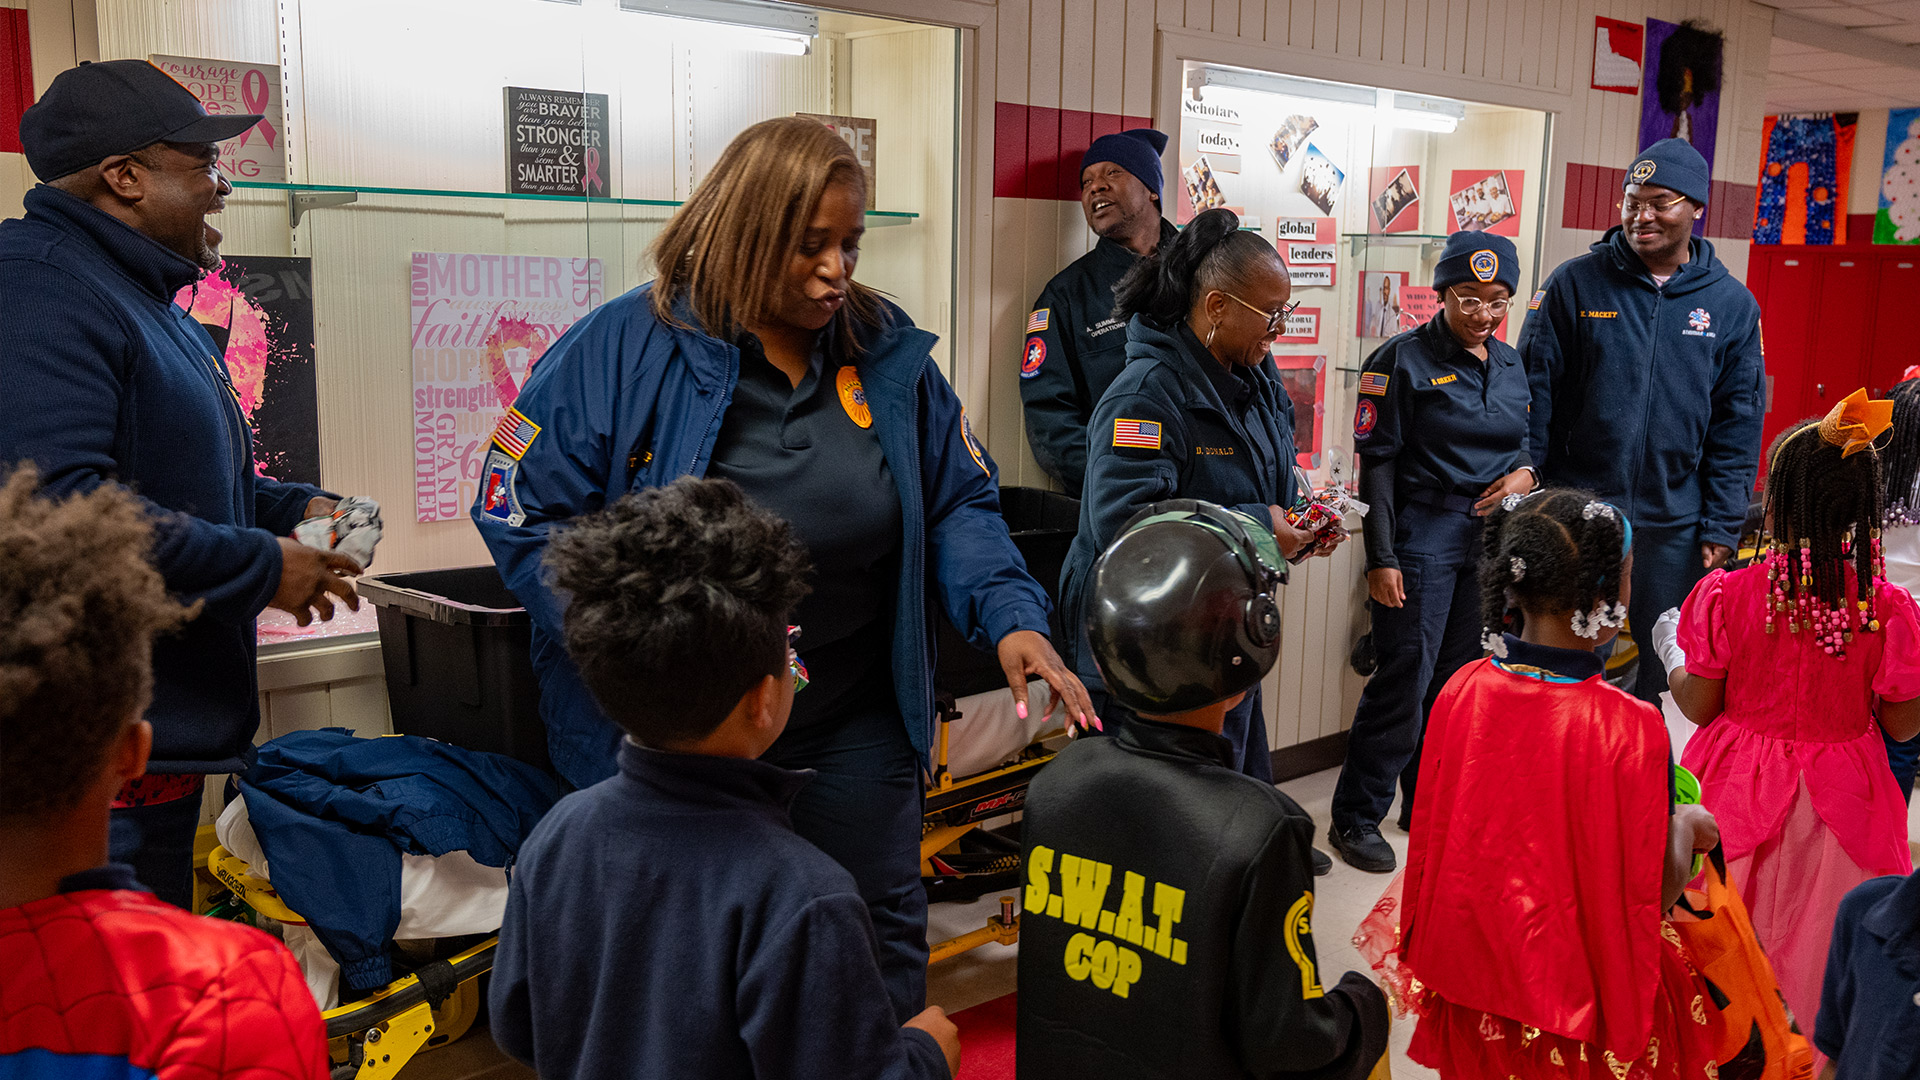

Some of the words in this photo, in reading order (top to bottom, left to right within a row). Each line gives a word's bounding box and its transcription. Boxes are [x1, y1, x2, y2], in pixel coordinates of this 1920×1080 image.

[181, 80, 237, 102] OPE
[518, 93, 552, 103] ALWAYS
[554, 96, 600, 106] REMEMBER
[516, 101, 538, 110] you
[539, 103, 600, 119] BRAVER
[1184, 99, 1239, 118] Scholars
[518, 114, 540, 124] than
[541, 118, 565, 127] you
[567, 118, 598, 128] believe
[516, 124, 601, 147] STRONGER
[1201, 132, 1239, 149] today.
[520, 143, 539, 153] than
[538, 148, 558, 157] you
[559, 145, 580, 166] &
[518, 163, 579, 184] SMARTER
[520, 182, 537, 190] than
[1280, 221, 1316, 237] global
[1291, 246, 1333, 260] leaders
[411, 253, 429, 307] LOVE
[430, 253, 563, 299] MOTHER
[1588, 310, 1618, 318] MACKEY
[1090, 321, 1126, 338] OPERATIONS
[415, 382, 499, 412] strength
[415, 410, 437, 523] MOTHER
[436, 413, 458, 518] GRAND
[1024, 845, 1188, 965] S.W.A.T.
[1064, 932, 1142, 998] COP
